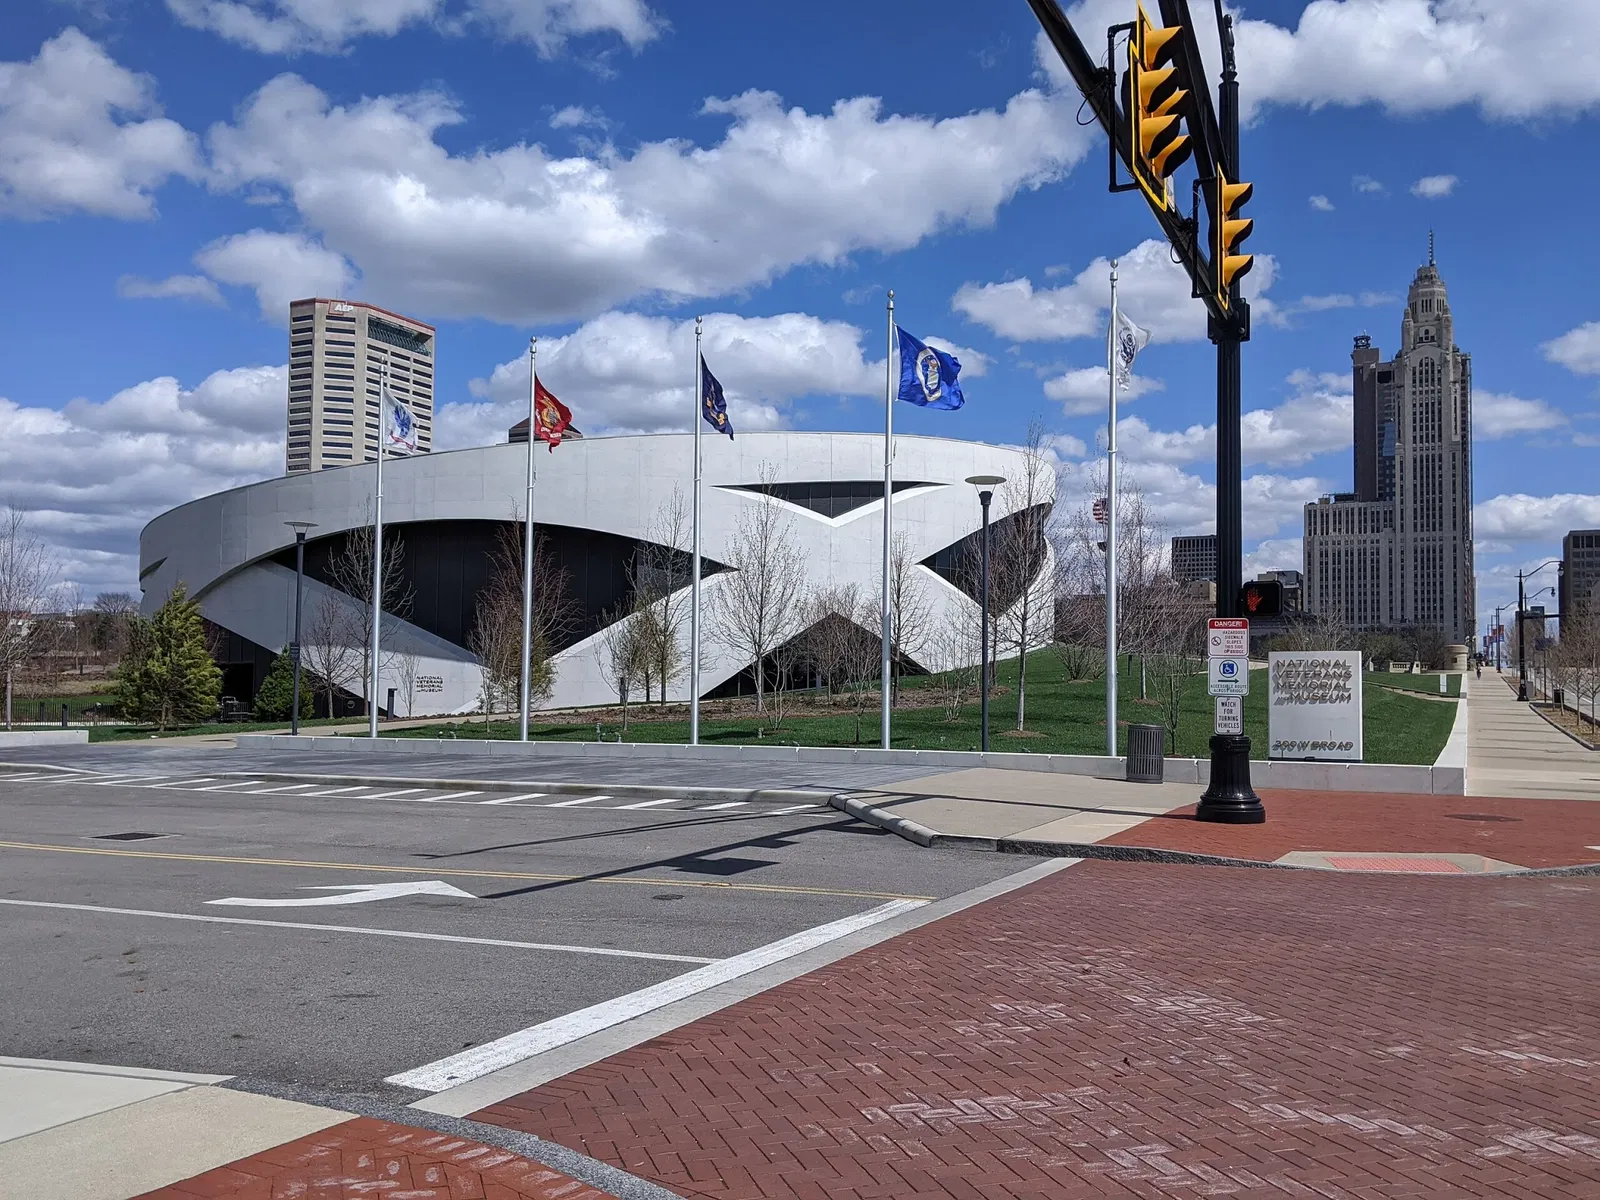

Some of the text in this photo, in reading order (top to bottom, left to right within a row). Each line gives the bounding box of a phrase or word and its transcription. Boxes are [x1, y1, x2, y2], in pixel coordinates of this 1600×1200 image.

[1276, 659, 1352, 669] NATIONAL
[1276, 670, 1352, 679] VETERANS
[1276, 681, 1352, 691] MEMORIAL
[1290, 693, 1352, 702] MUSEUM
[1311, 740, 1354, 751] BROAD
